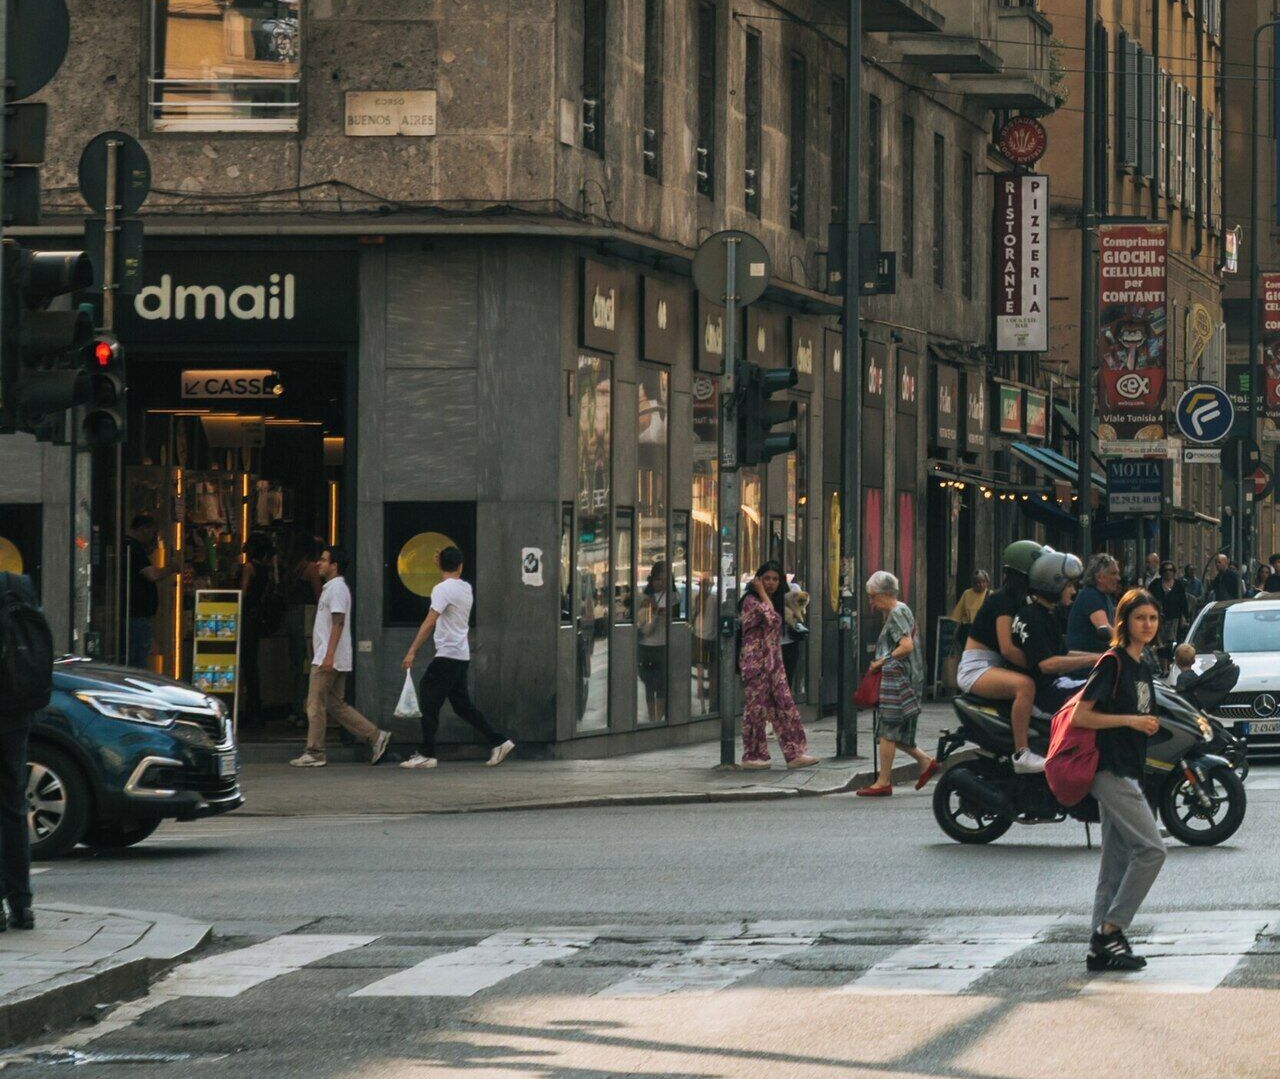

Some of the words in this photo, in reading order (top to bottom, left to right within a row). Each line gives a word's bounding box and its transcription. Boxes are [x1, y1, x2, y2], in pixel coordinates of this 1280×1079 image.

[347, 115, 391, 126] BUENOS
[401, 115, 434, 126] AIRES
[1003, 181, 1017, 313] RISTORANTE
[1029, 181, 1041, 313] PIZZERIA
[1102, 237, 1165, 248] Compriamo
[1103, 251, 1156, 263] GIOCHI
[1102, 266, 1165, 277] CELLULARI
[1124, 280, 1143, 289] per
[133, 273, 295, 320] dmail
[1102, 291, 1165, 302] CONTANTI
[1103, 414, 1125, 422] Viale
[1127, 414, 1156, 422] Tunisia
[1158, 414, 1163, 422] 4
[1111, 463, 1160, 476] MOTTA
